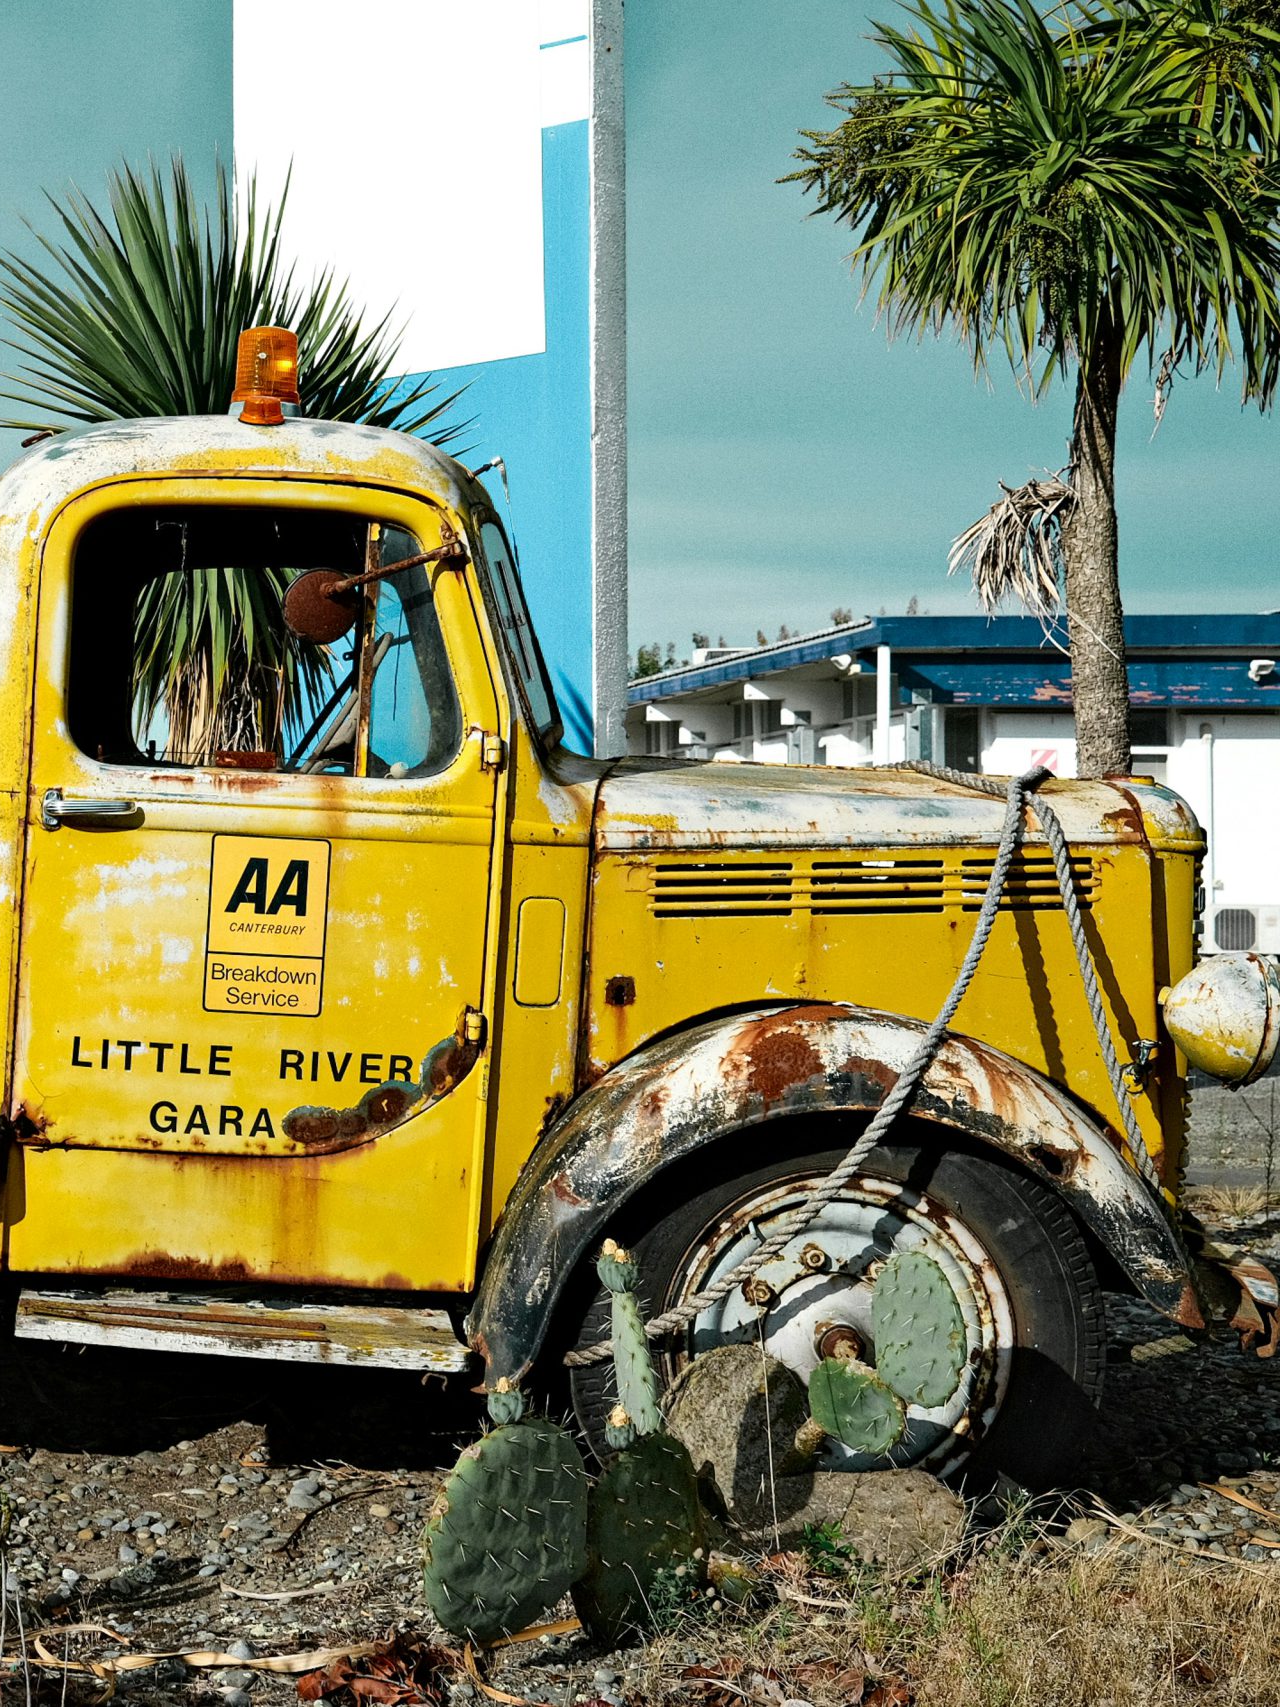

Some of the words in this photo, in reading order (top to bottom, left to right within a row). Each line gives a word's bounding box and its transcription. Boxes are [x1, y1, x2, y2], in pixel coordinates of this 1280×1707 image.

[224, 857, 309, 917] AA
[229, 922, 306, 936] CANTERBURY
[211, 963, 317, 985] Breakdown
[226, 987, 299, 1008] Service
[71, 1036, 233, 1076] LITTLE
[279, 1048, 414, 1085] RIVER
